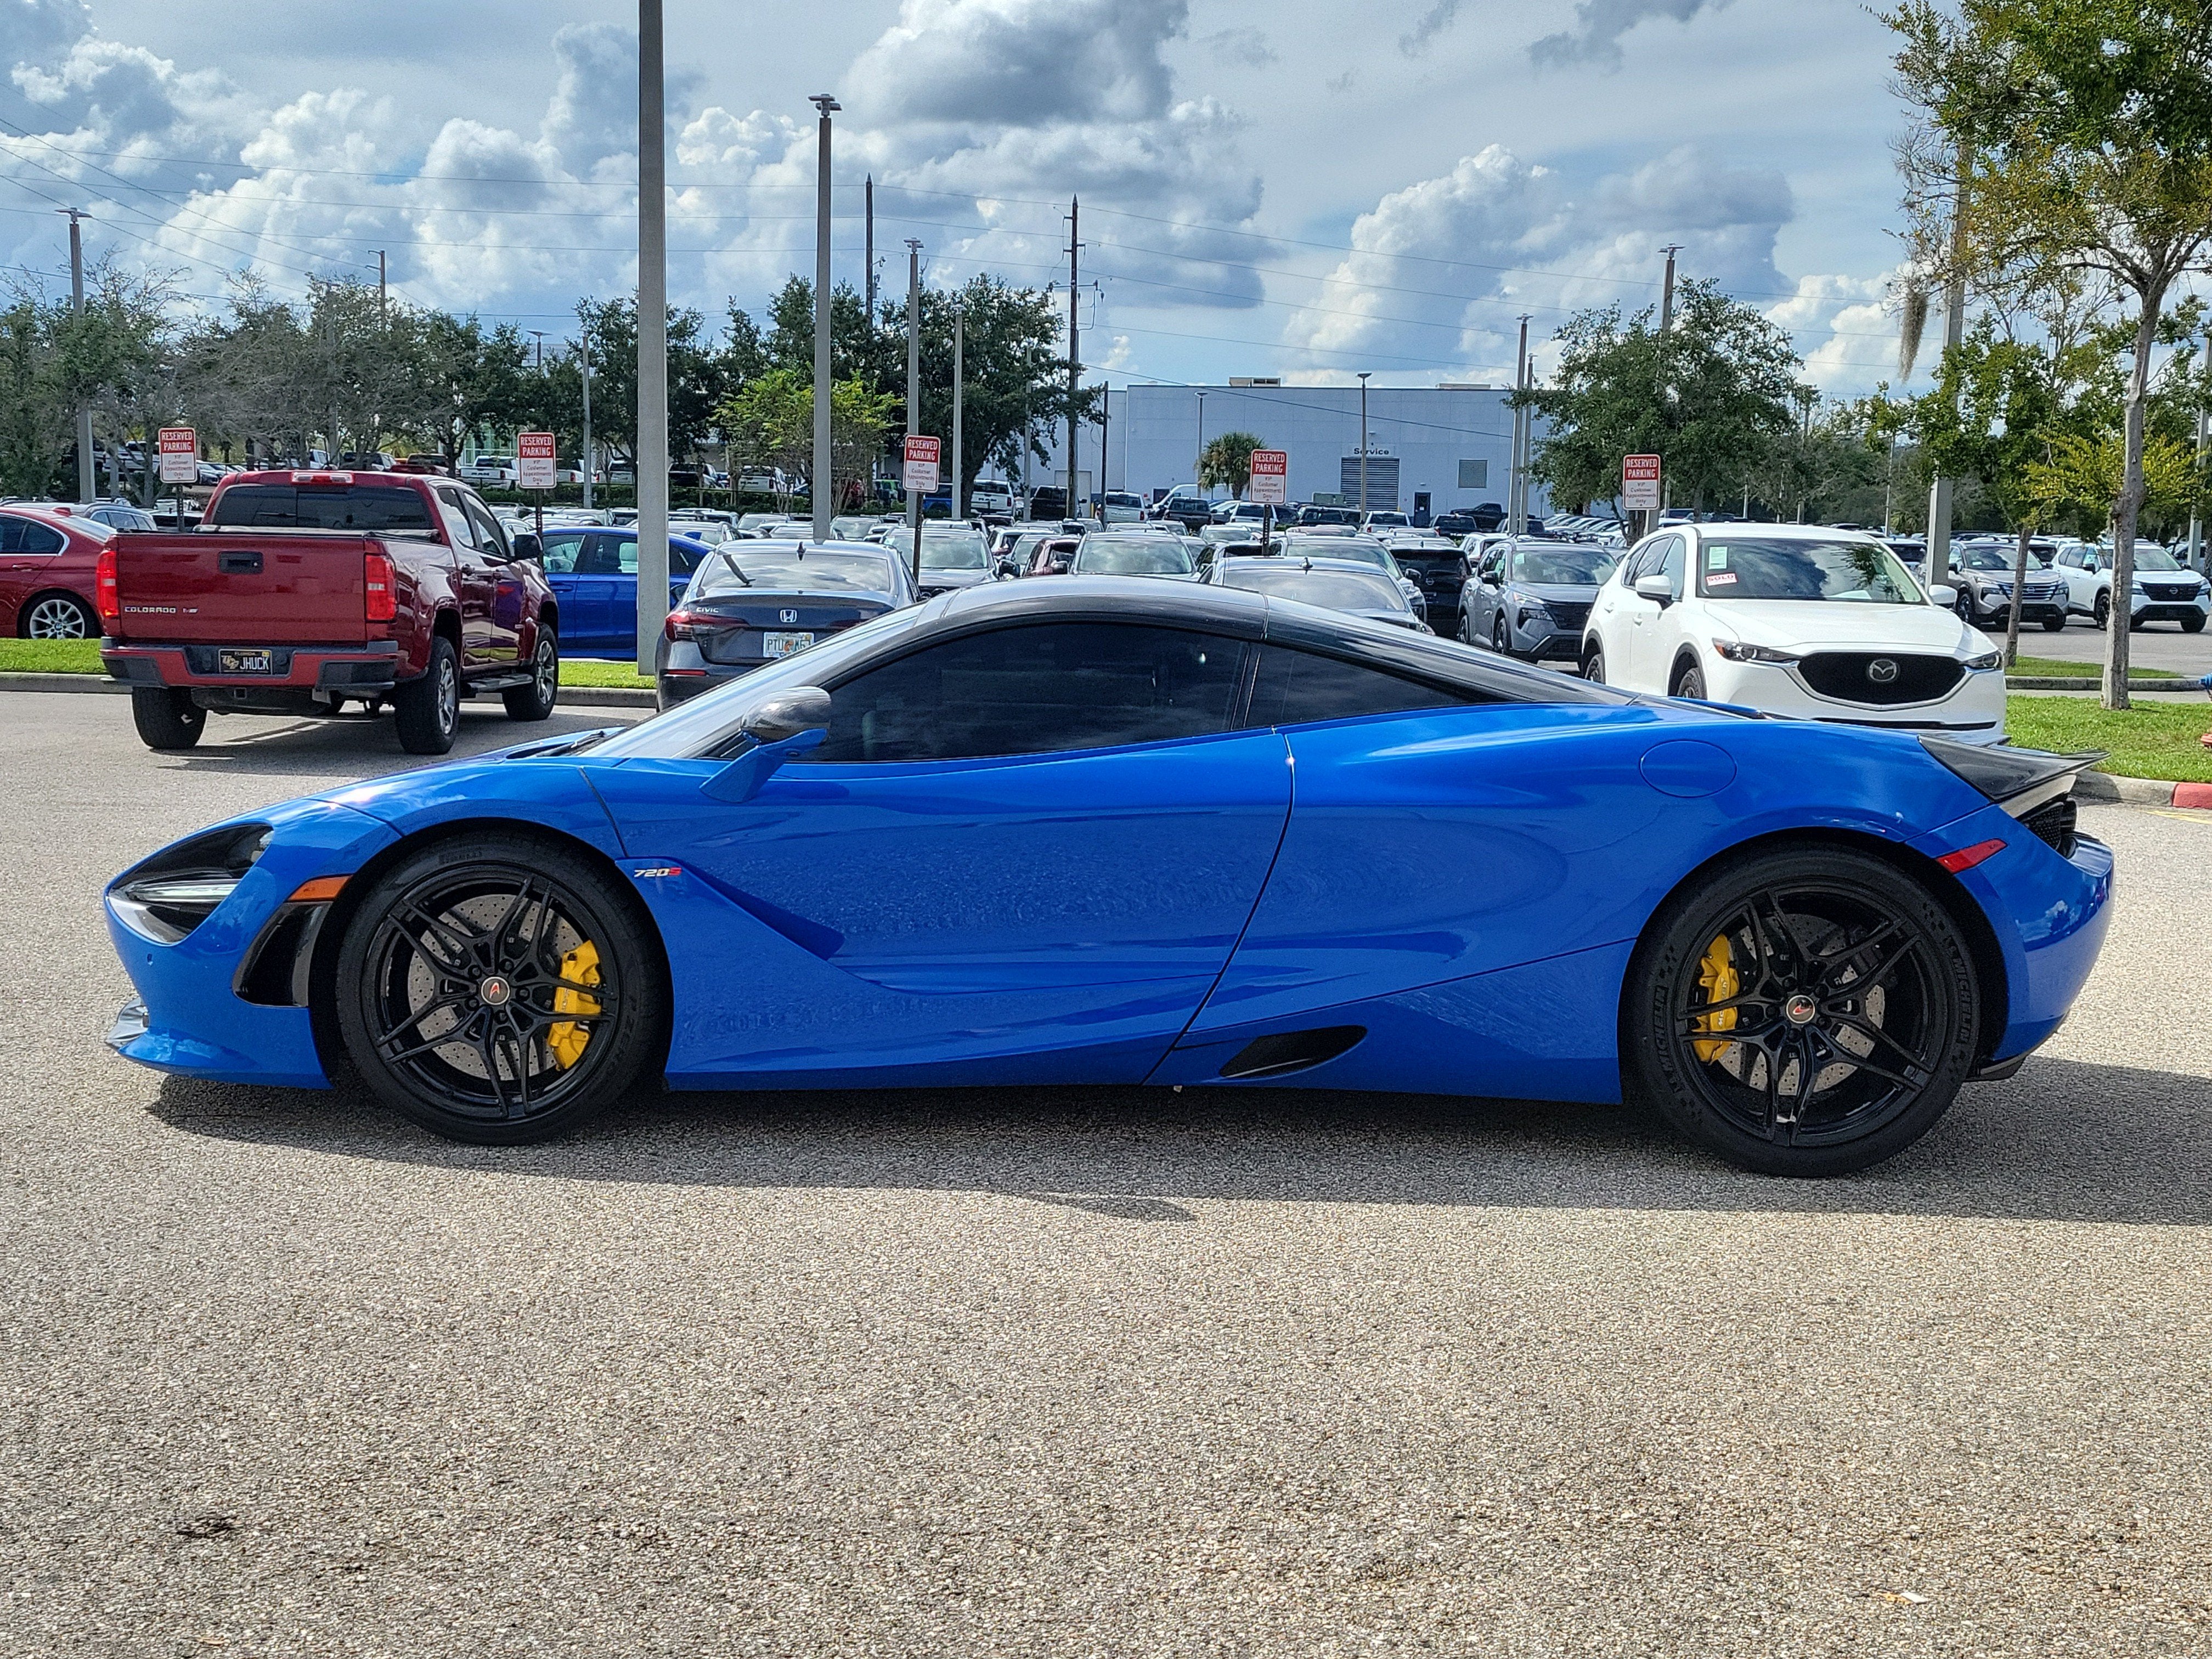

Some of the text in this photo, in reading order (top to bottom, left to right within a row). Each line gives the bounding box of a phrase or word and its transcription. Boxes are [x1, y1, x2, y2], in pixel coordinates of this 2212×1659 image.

[161, 432, 193, 441] RESERVED
[521, 437, 552, 445] RESERVED
[163, 442, 191, 451] PARKING
[908, 439, 938, 450] RESERVED
[522, 447, 550, 456] PARKING
[909, 449, 935, 460] PARKING
[1254, 453, 1285, 463] RESERVED
[1627, 459, 1657, 467] RESERVED
[1256, 463, 1283, 473] PARKING
[1628, 469, 1656, 478] PARKING
[240, 657, 269, 670] JHUCK
[634, 867, 681, 878] 720S
[1953, 956, 1972, 1043] MICHELIN
[1653, 988, 1673, 1073] MICHELIN
